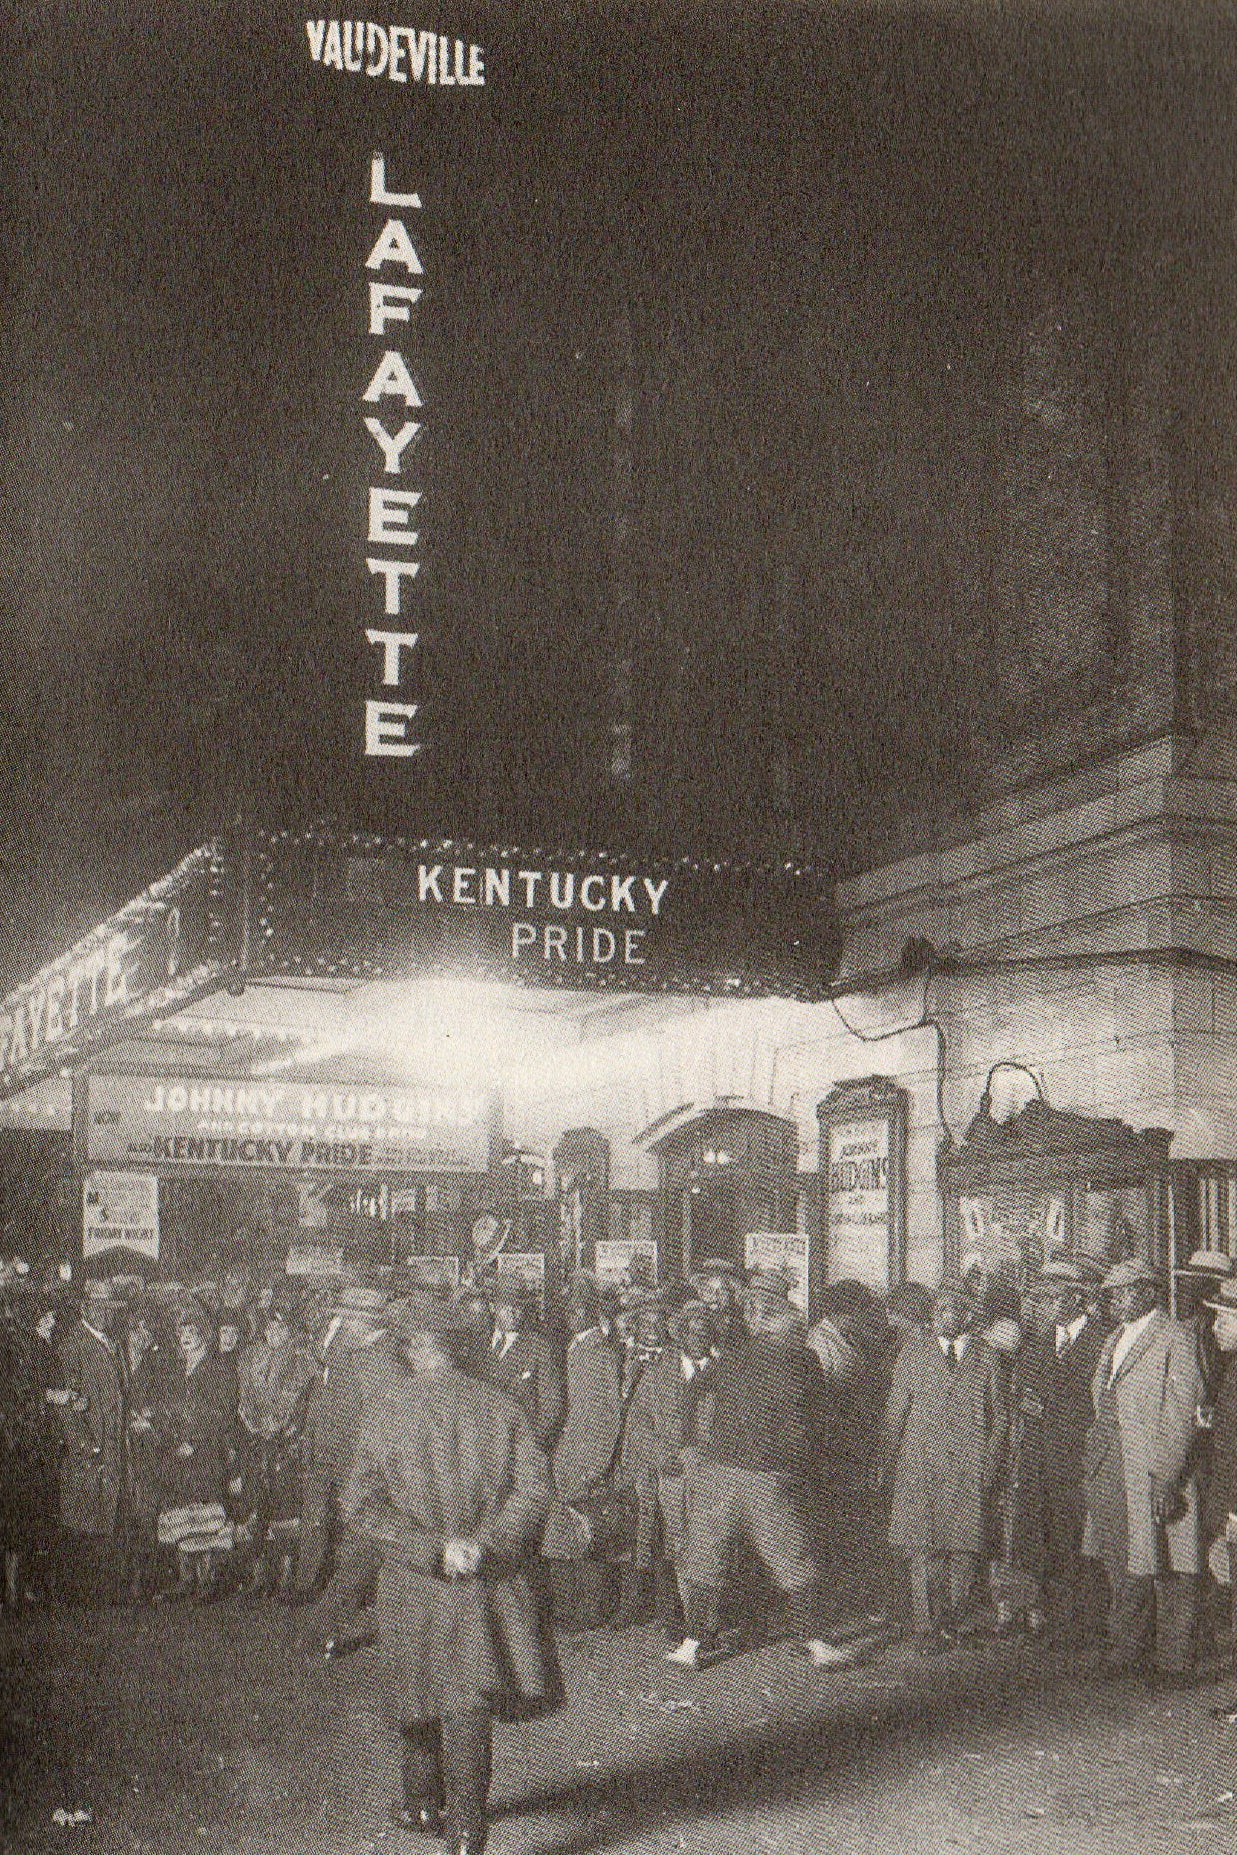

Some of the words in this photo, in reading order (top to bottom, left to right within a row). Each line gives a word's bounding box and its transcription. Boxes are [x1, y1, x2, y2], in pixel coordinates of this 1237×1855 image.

[306, 19, 486, 86] VAUDEVILLE
[362, 150, 424, 758] LAFAYETTE
[417, 864, 668, 915] KENTUCKY
[512, 922, 646, 964] PRIDE
[143, 1085, 285, 1117] JOHNNY
[153, 1135, 293, 1163] KENTUCKY
[301, 1141, 374, 1166] PRIDE
